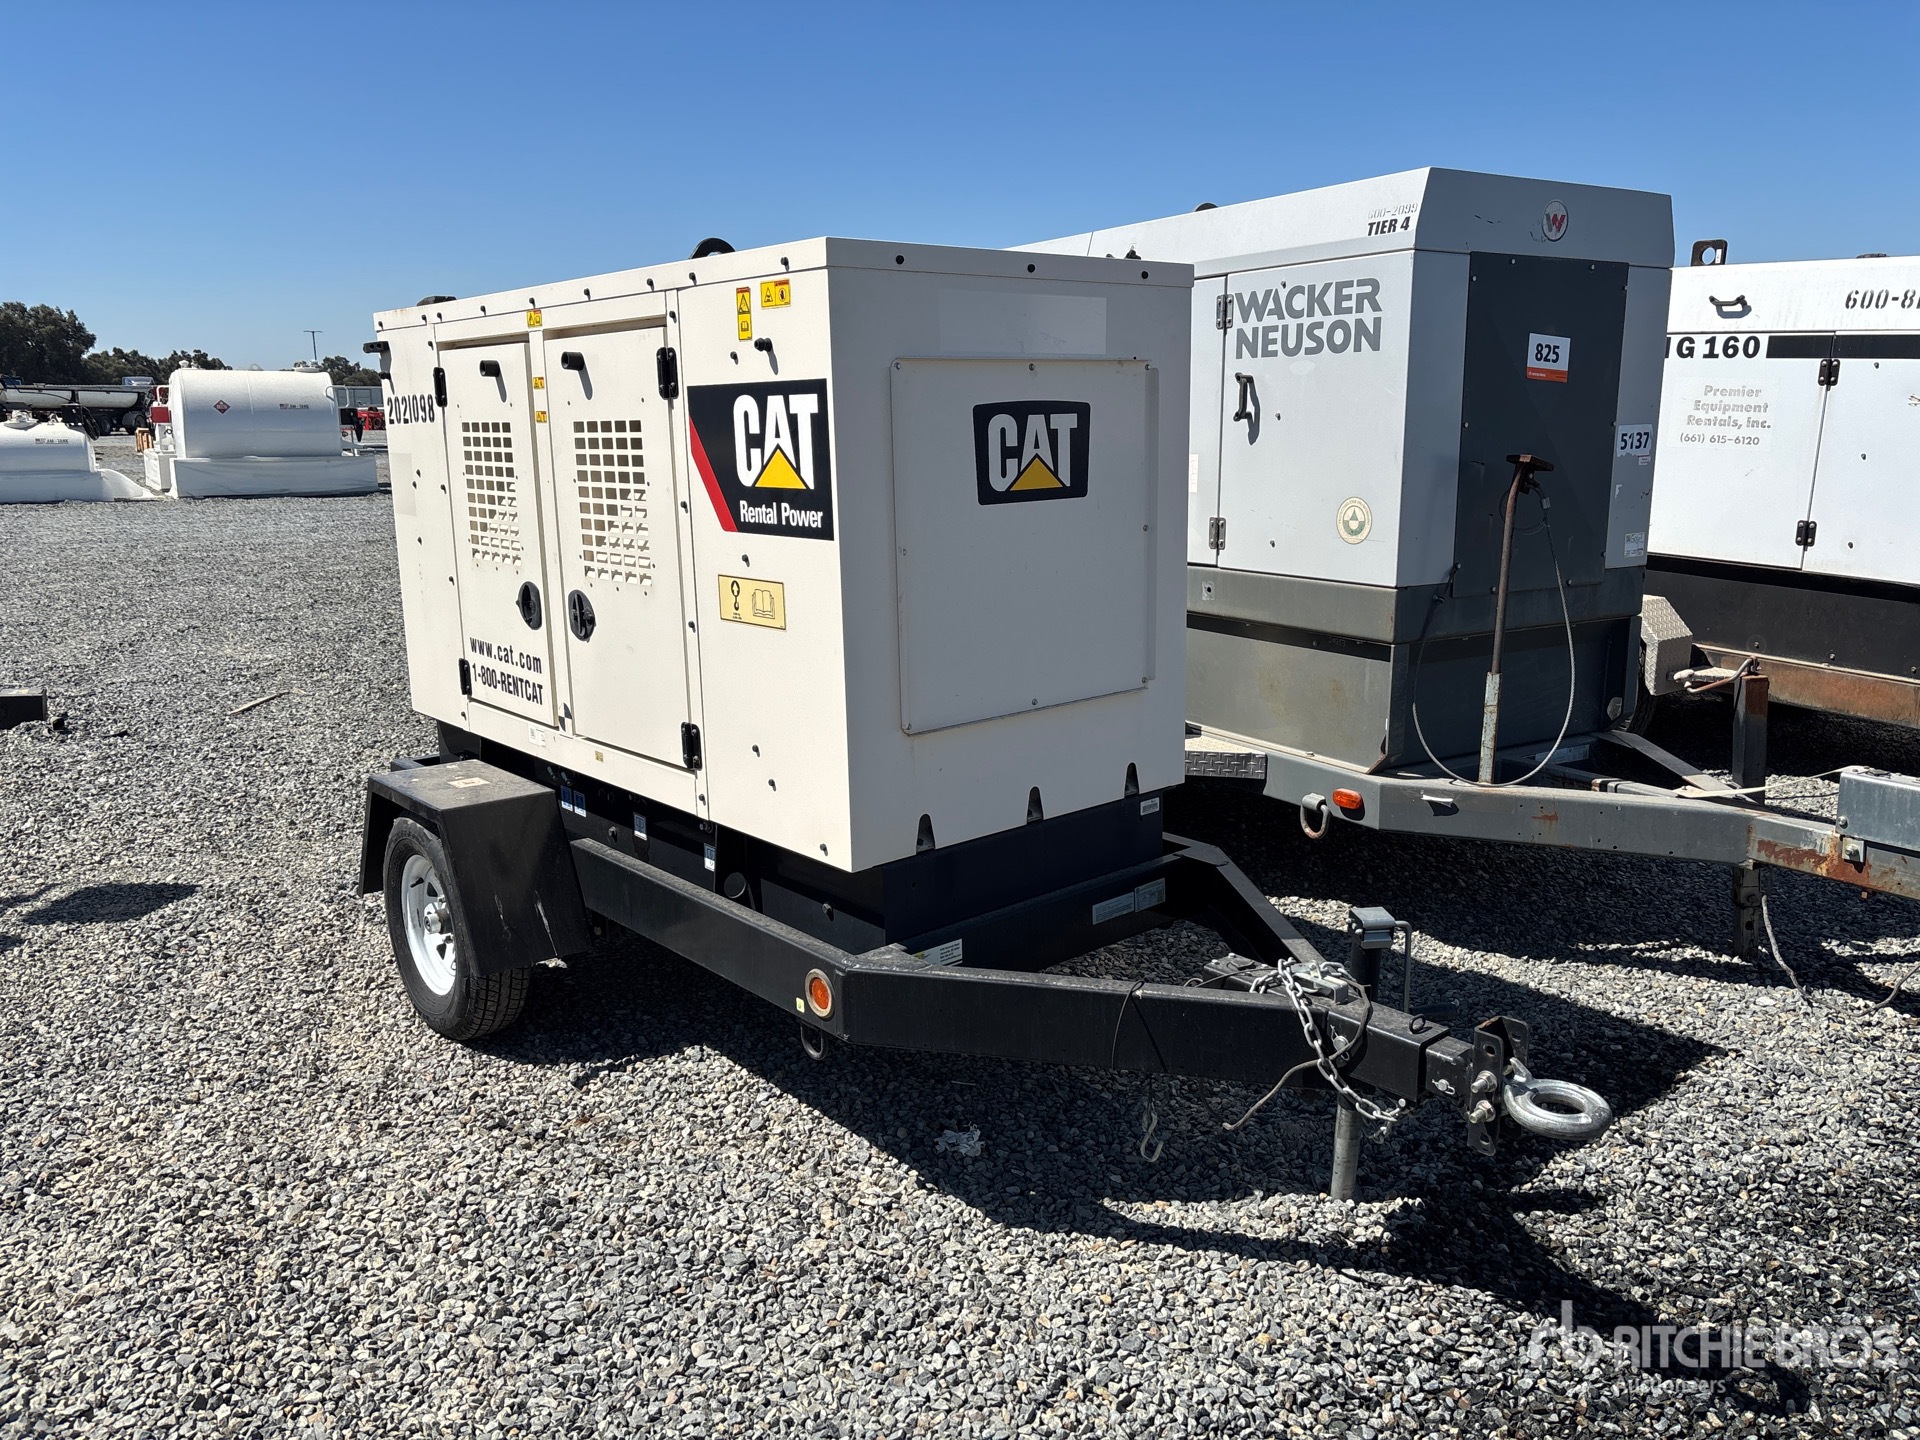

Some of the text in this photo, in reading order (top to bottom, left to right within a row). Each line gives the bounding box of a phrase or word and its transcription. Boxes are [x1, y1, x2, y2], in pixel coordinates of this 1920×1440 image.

[1367, 216, 1411, 237] TIER 4
[1234, 277, 1383, 324] WACKER
[1235, 316, 1382, 360] NEUSON
[1534, 342, 1561, 364] 825
[1703, 384, 1763, 398] Premier
[1692, 399, 1770, 415] Equipment
[733, 393, 819, 490] CAT
[987, 412, 1078, 492] CAT
[1620, 431, 1651, 451] 5137
[1680, 432, 1761, 446] (661) 615-6120
[739, 500, 824, 529] Rental Power
[469, 636, 543, 675] www.cat.com
[472, 662, 544, 706] 1-800-RENTCAT
